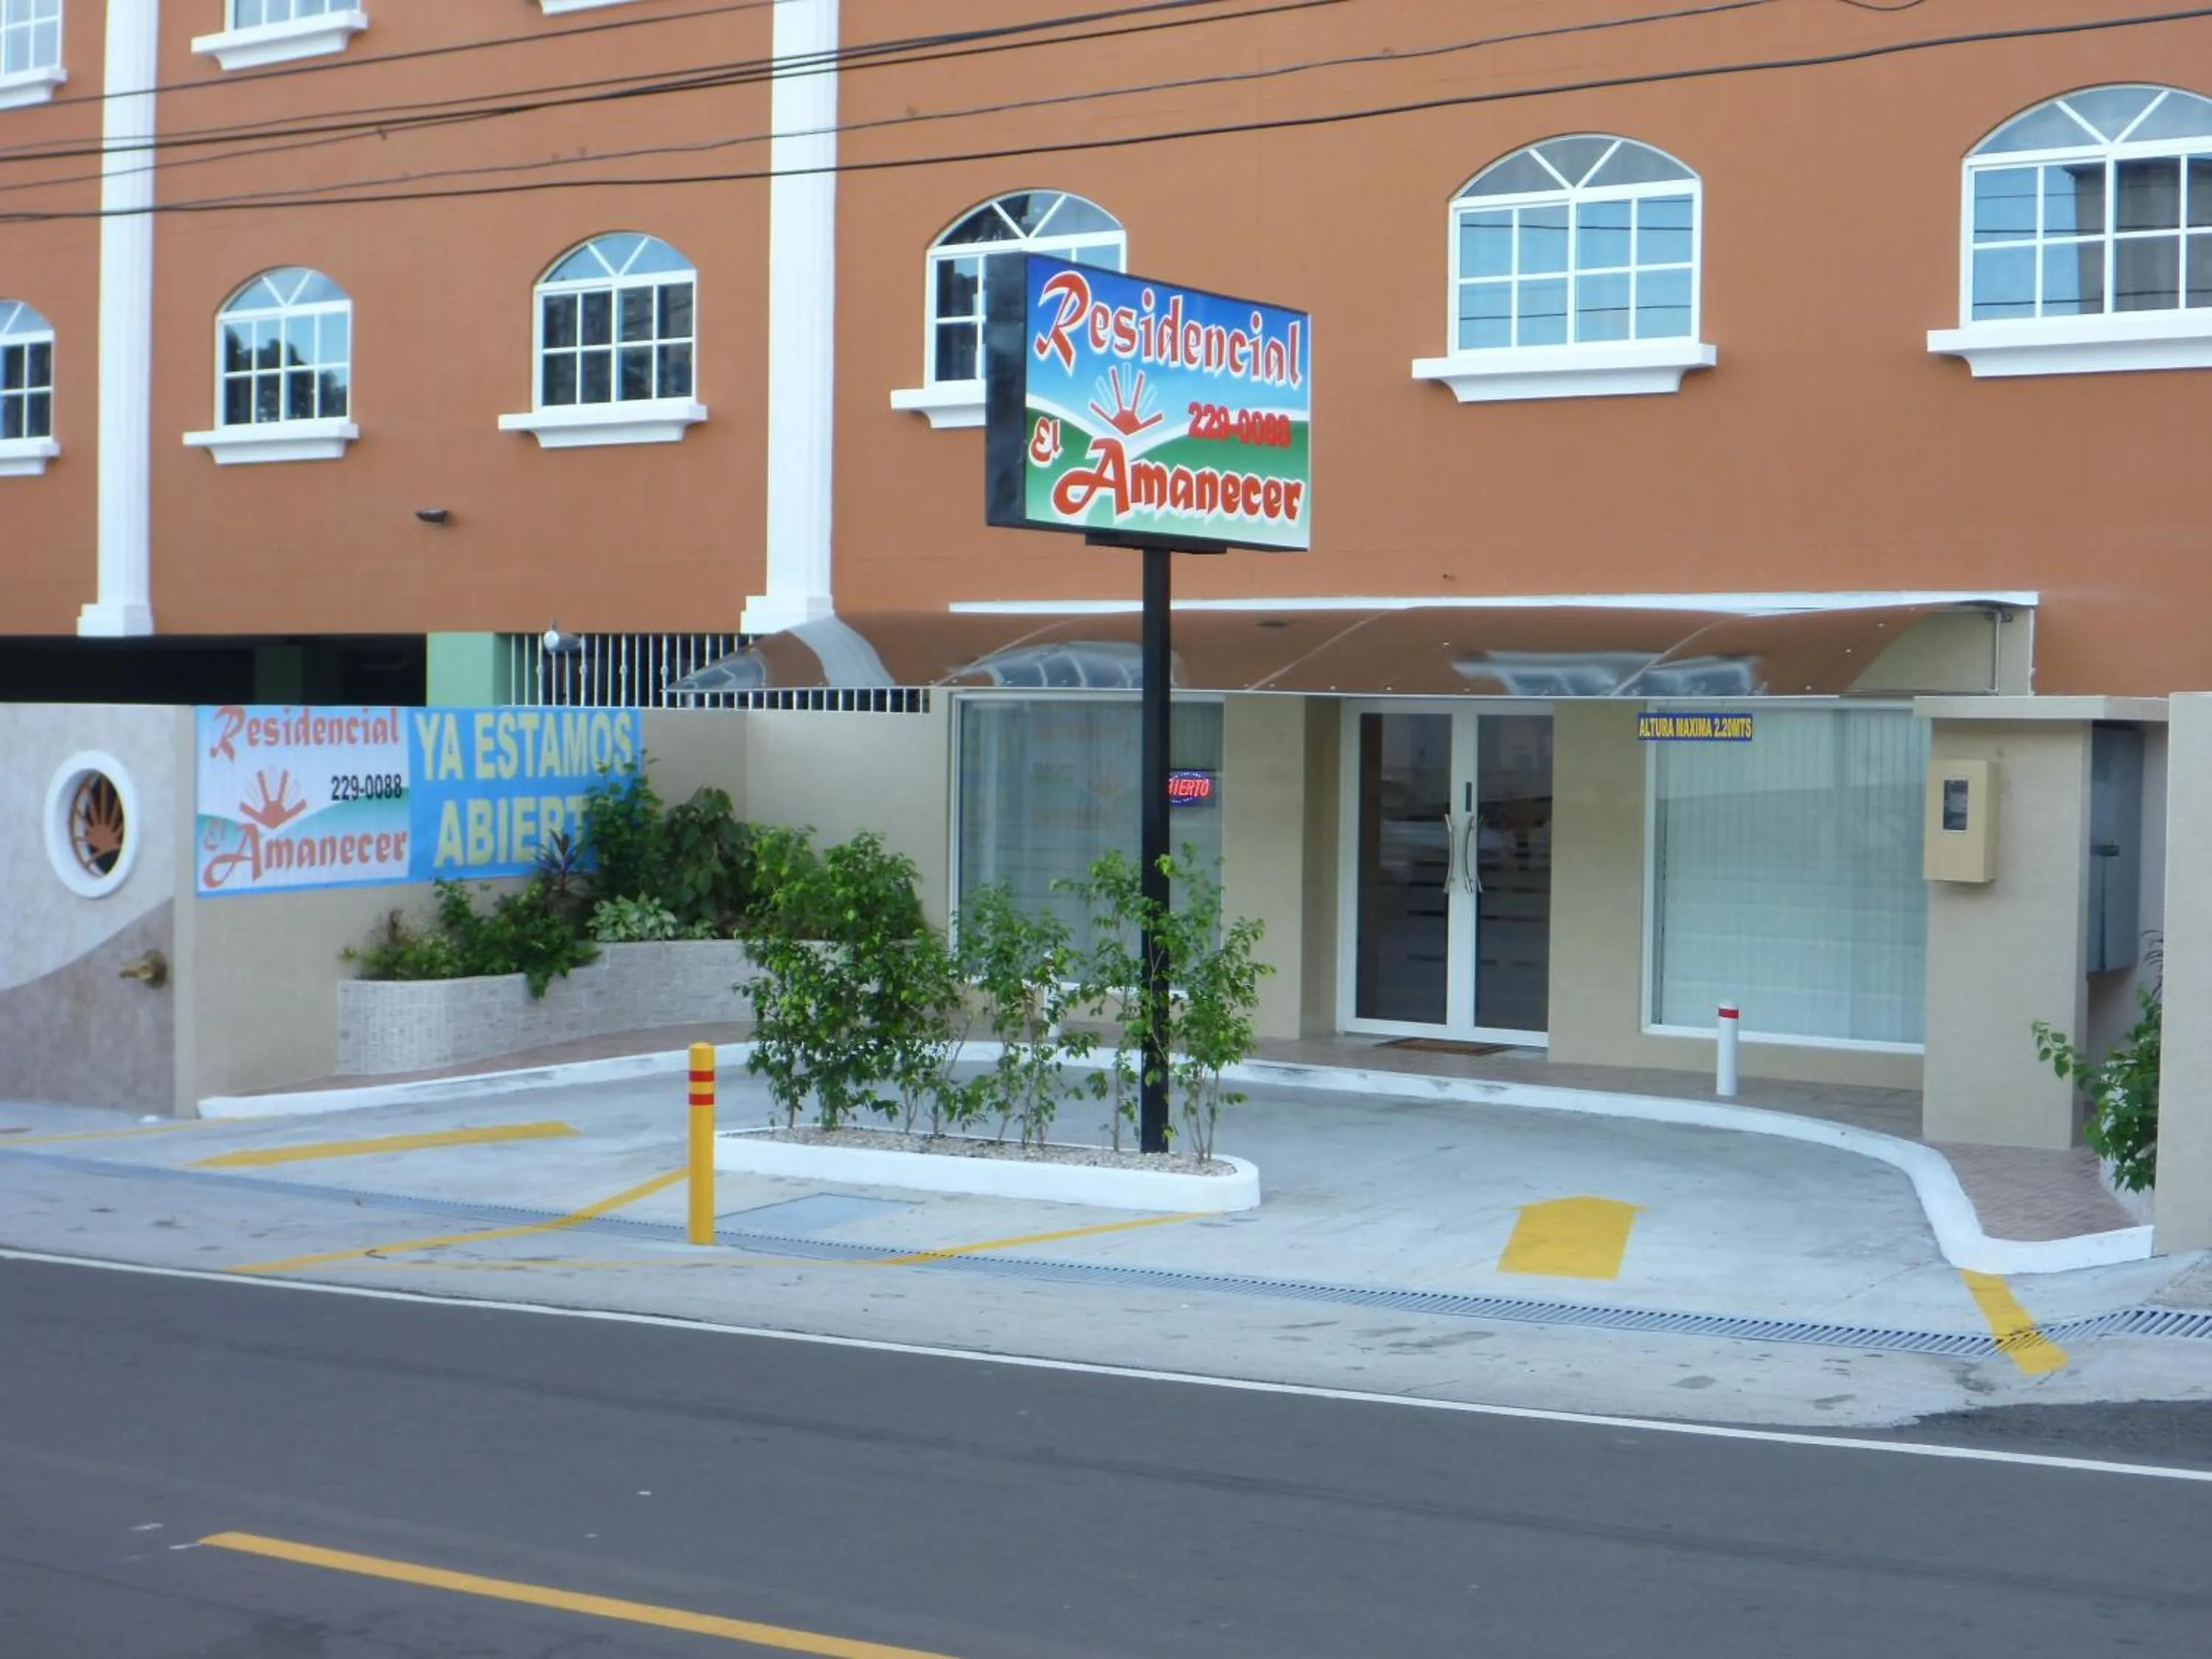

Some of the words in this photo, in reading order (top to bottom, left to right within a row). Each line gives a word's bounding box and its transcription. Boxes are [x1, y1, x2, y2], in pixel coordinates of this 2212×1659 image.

[1034, 271, 1303, 388] Residencial
[1029, 416, 1062, 465] El
[1051, 438, 1304, 521] Amanecer
[209, 705, 400, 762] Residencial
[414, 712, 463, 780] YA
[474, 712, 634, 776] ESTAMOS
[1639, 717, 1674, 737] ALTURA
[330, 774, 403, 801] 229-0088
[202, 823, 408, 888] Amanecer
